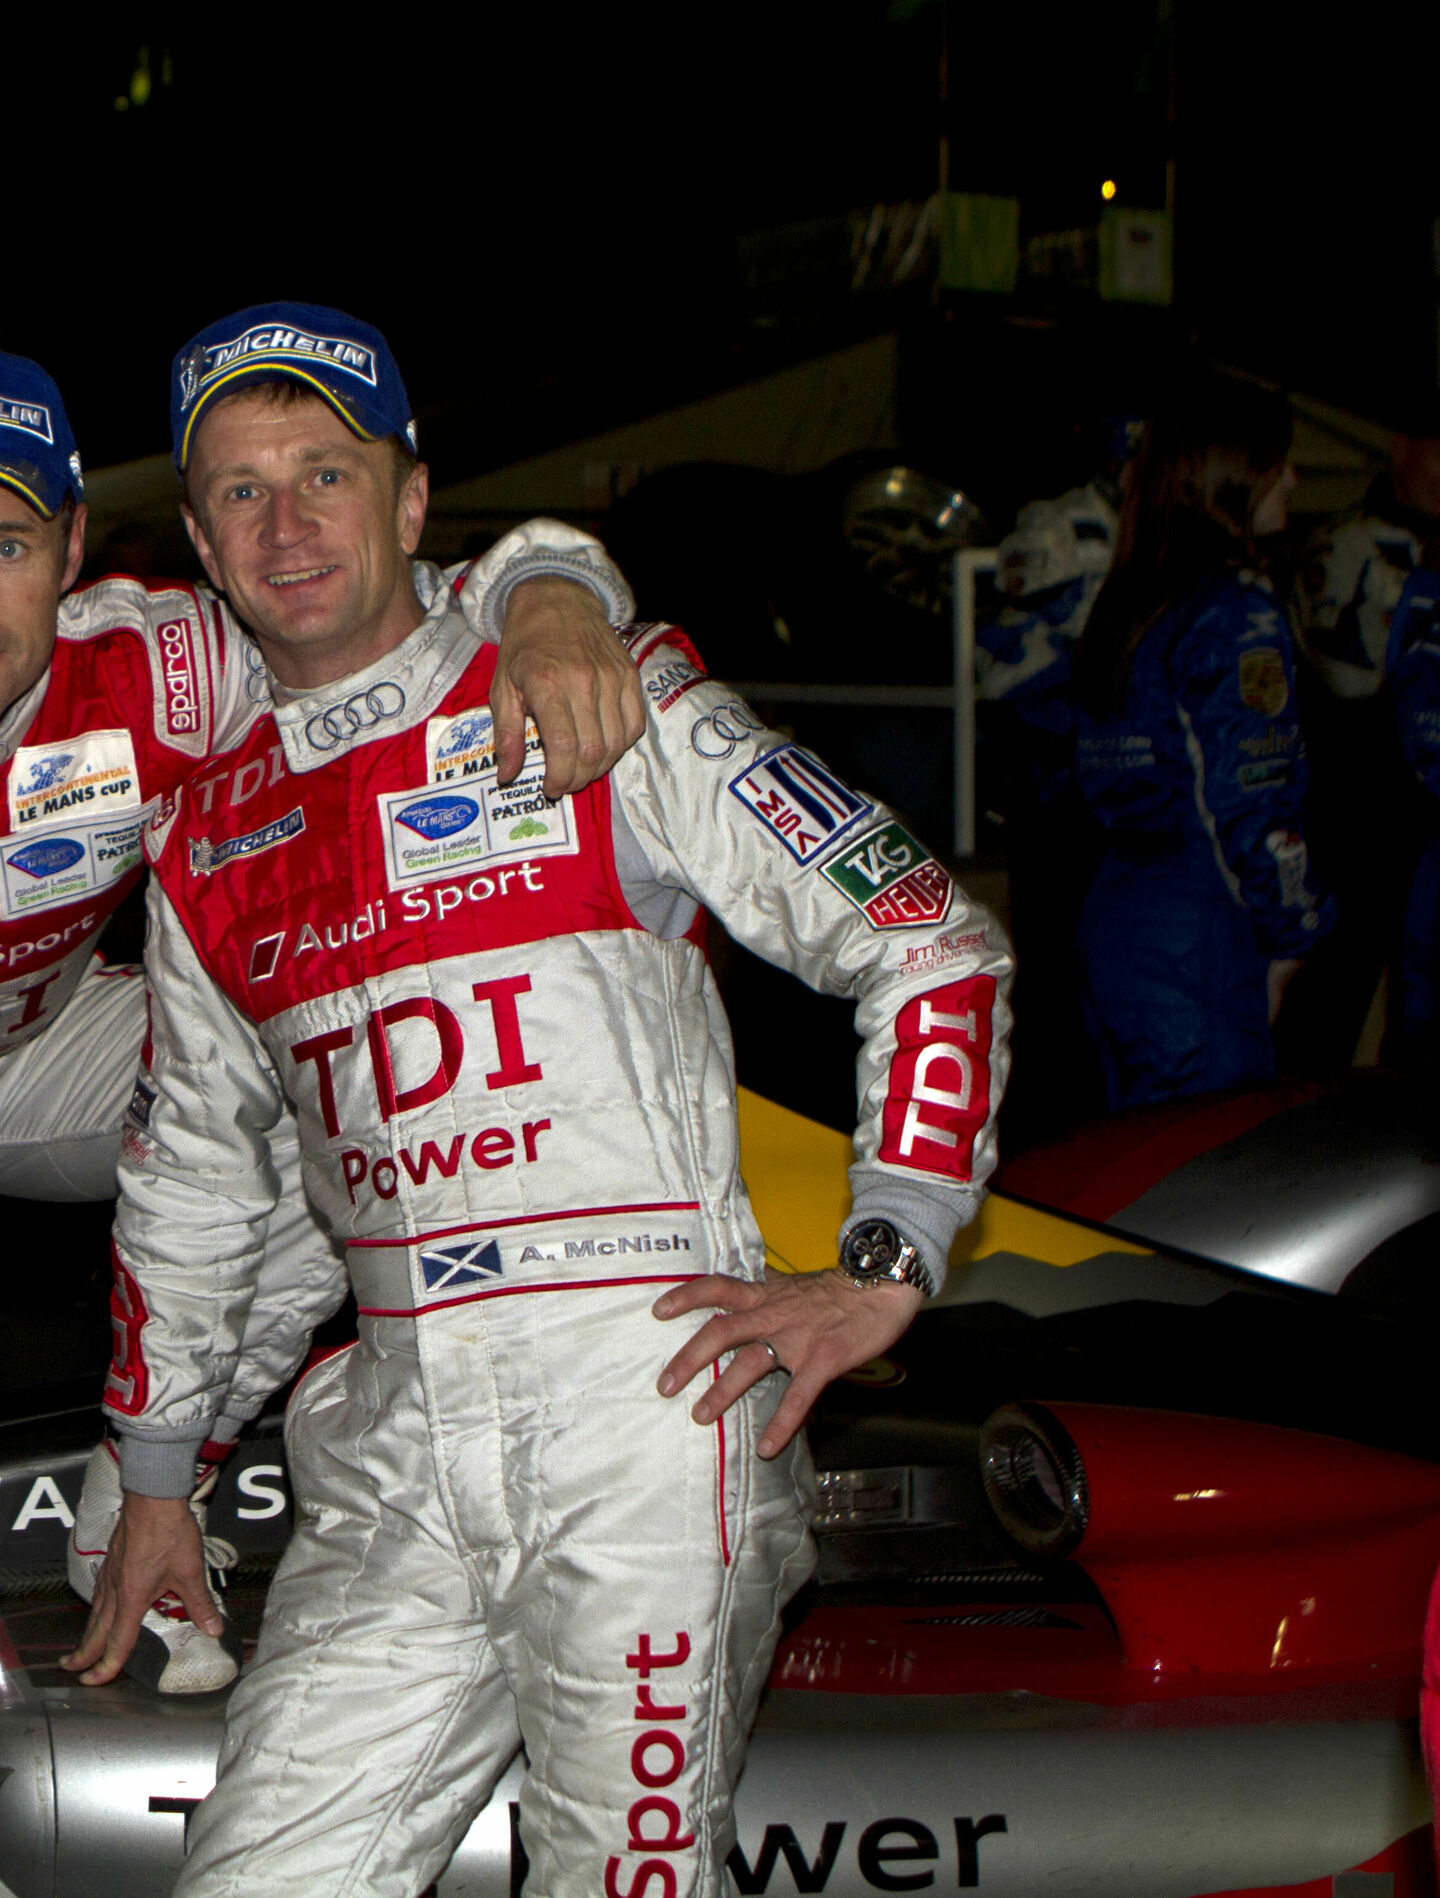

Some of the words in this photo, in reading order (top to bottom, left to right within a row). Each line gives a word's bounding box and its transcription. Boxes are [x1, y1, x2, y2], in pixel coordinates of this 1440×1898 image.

[213, 330, 367, 368] MICHELIN
[162, 625, 198, 729] sparco
[16, 765, 131, 809] INTERCONTINENTAL
[195, 744, 285, 814] TDI
[500, 785, 543, 800] TEQUILA
[19, 806, 37, 823] LE
[43, 786, 95, 815] MANS
[417, 817, 428, 828] LE
[430, 812, 454, 826] MANS
[745, 777, 821, 855] IMSA
[218, 813, 300, 859] MICHELIN
[402, 844, 438, 860] Global
[442, 835, 481, 851] Leader
[405, 855, 441, 869] Green
[443, 844, 482, 861] Racing
[845, 834, 913, 888] TAG
[15, 880, 48, 898] Global
[51, 872, 87, 886] Leader
[873, 865, 947, 923] HEUER
[293, 900, 387, 958] Audi
[401, 862, 544, 922] Sport
[899, 944, 936, 967] Jim
[291, 973, 543, 1139] TDI
[899, 1000, 977, 1156] TDI
[339, 1117, 552, 1205] Power
[518, 1243, 556, 1266] A.
[565, 1234, 691, 1258] McNish
[605, 1631, 695, 1897] Sport
